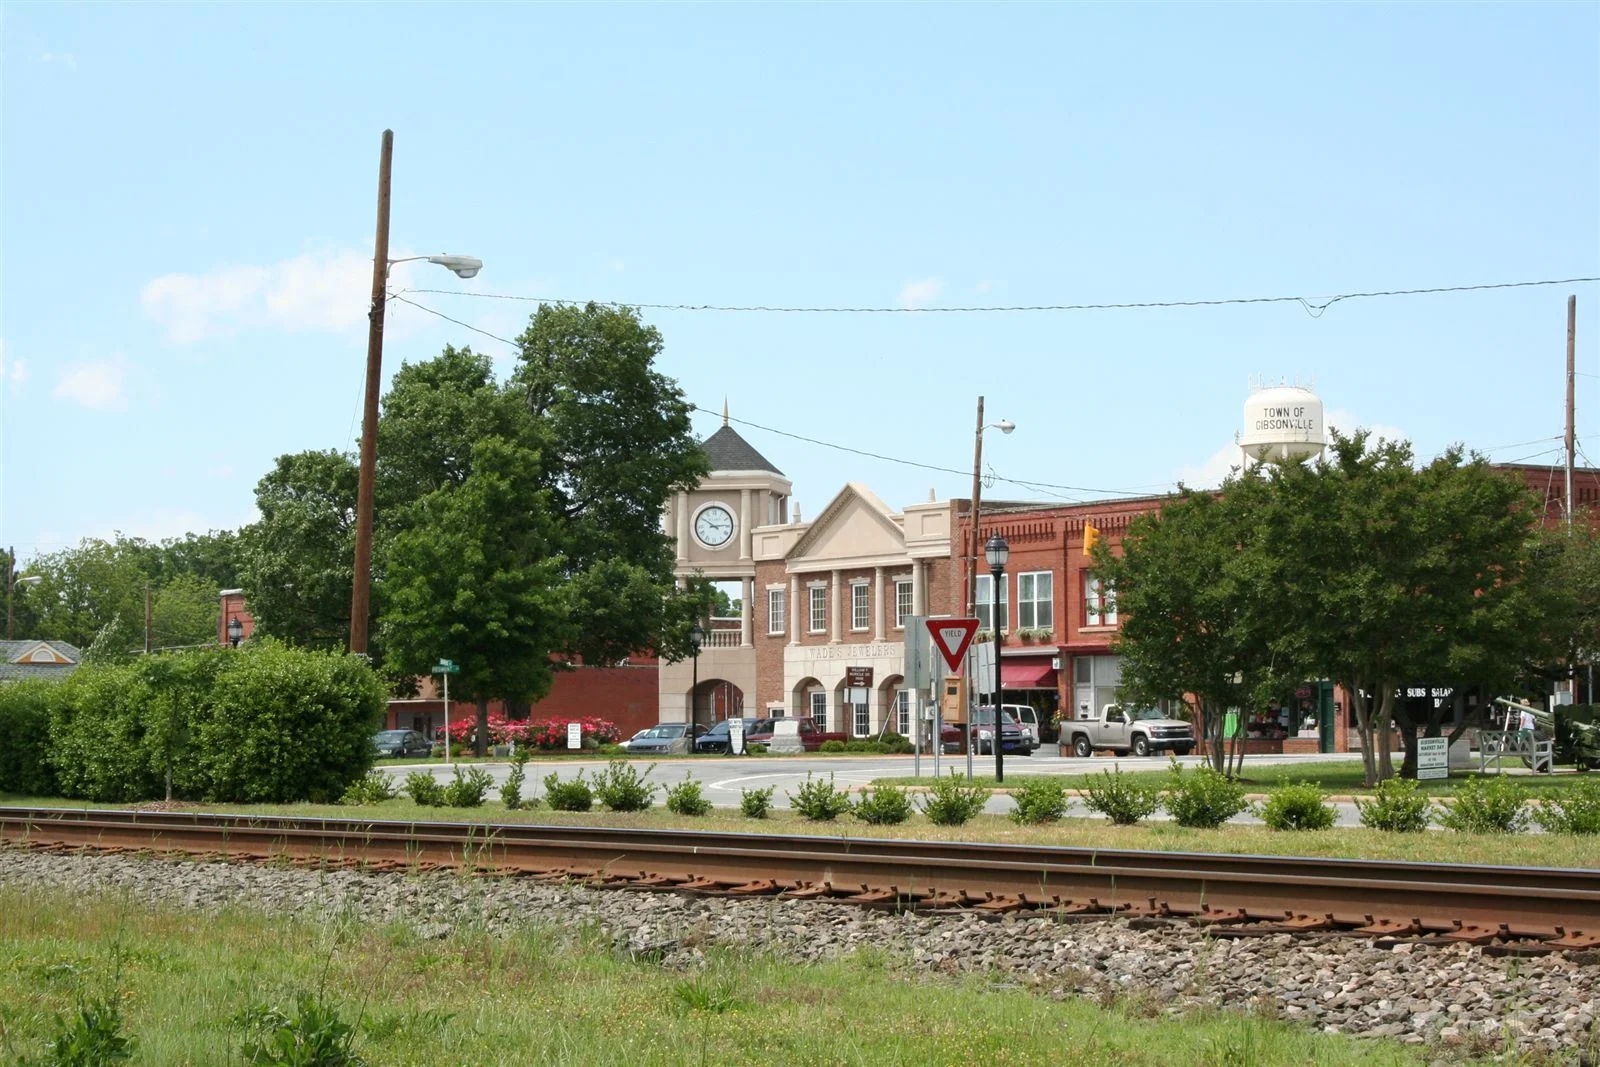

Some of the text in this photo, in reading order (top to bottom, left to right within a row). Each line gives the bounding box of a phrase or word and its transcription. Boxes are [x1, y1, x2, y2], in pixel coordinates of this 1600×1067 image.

[1263, 406, 1305, 418] TOWN OF
[1255, 419, 1313, 430] GIBSONVILLE
[944, 629, 962, 638] YIELD
[808, 645, 896, 659] WADE'S JEWELERS
[1406, 687, 1426, 697] SUBS
